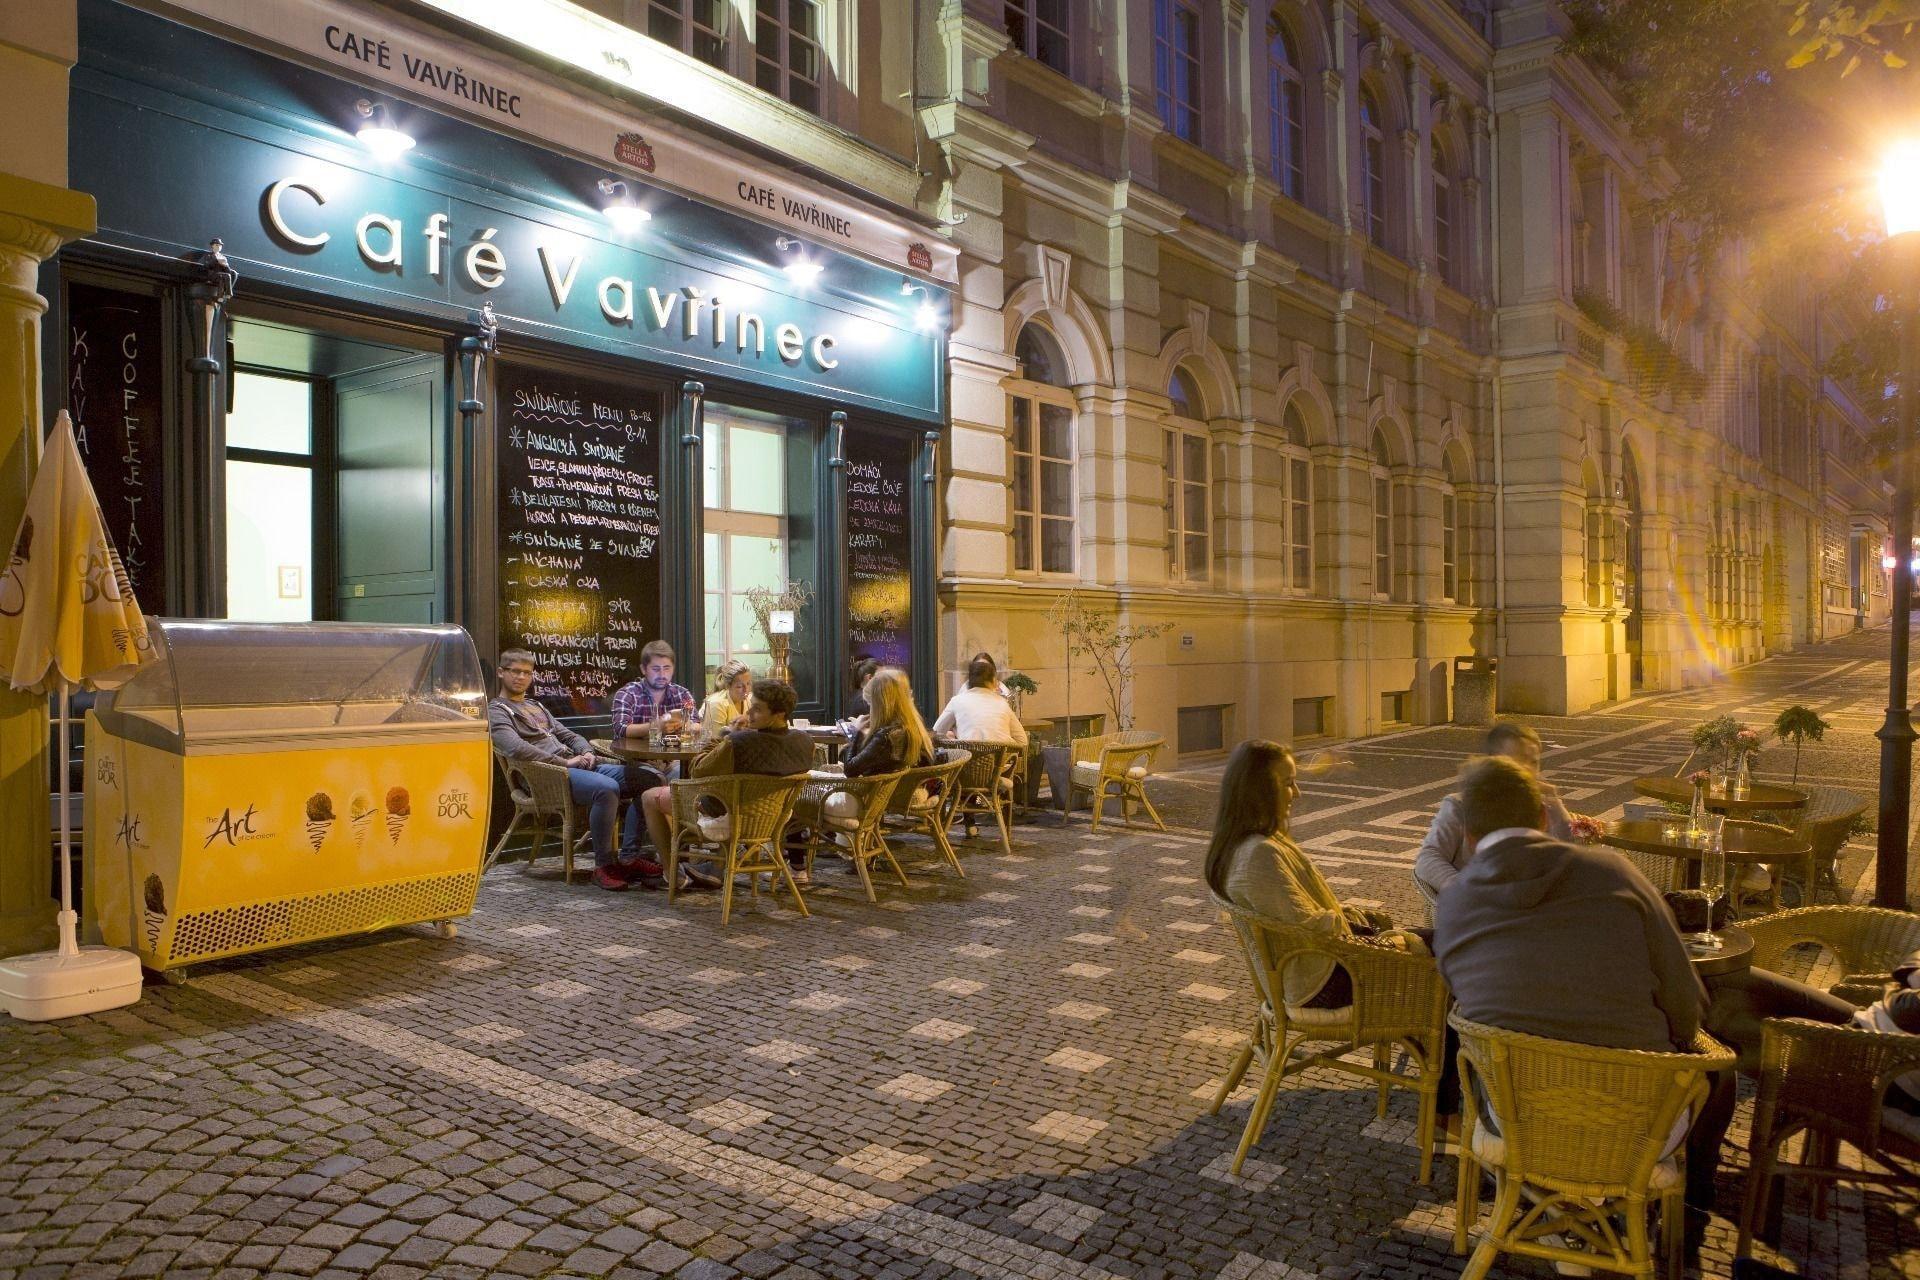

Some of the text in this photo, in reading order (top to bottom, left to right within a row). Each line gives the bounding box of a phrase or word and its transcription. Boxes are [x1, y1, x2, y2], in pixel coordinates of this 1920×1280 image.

[325, 26, 521, 118] CAFÉ VAVŘINEC
[621, 143, 648, 158] STELLA
[621, 152, 649, 166] ARTOIS
[738, 181, 851, 239] CAFÉ VAVŘINEC
[264, 176, 839, 370] Café Vavřinec
[122, 333, 142, 486] COFFEE
[593, 402, 623, 423] MENU
[608, 597, 632, 614] SÝR
[437, 802, 477, 819] D'OR
[438, 792, 470, 805] CARTE
[115, 812, 141, 850] Art
[203, 801, 260, 849] Art
